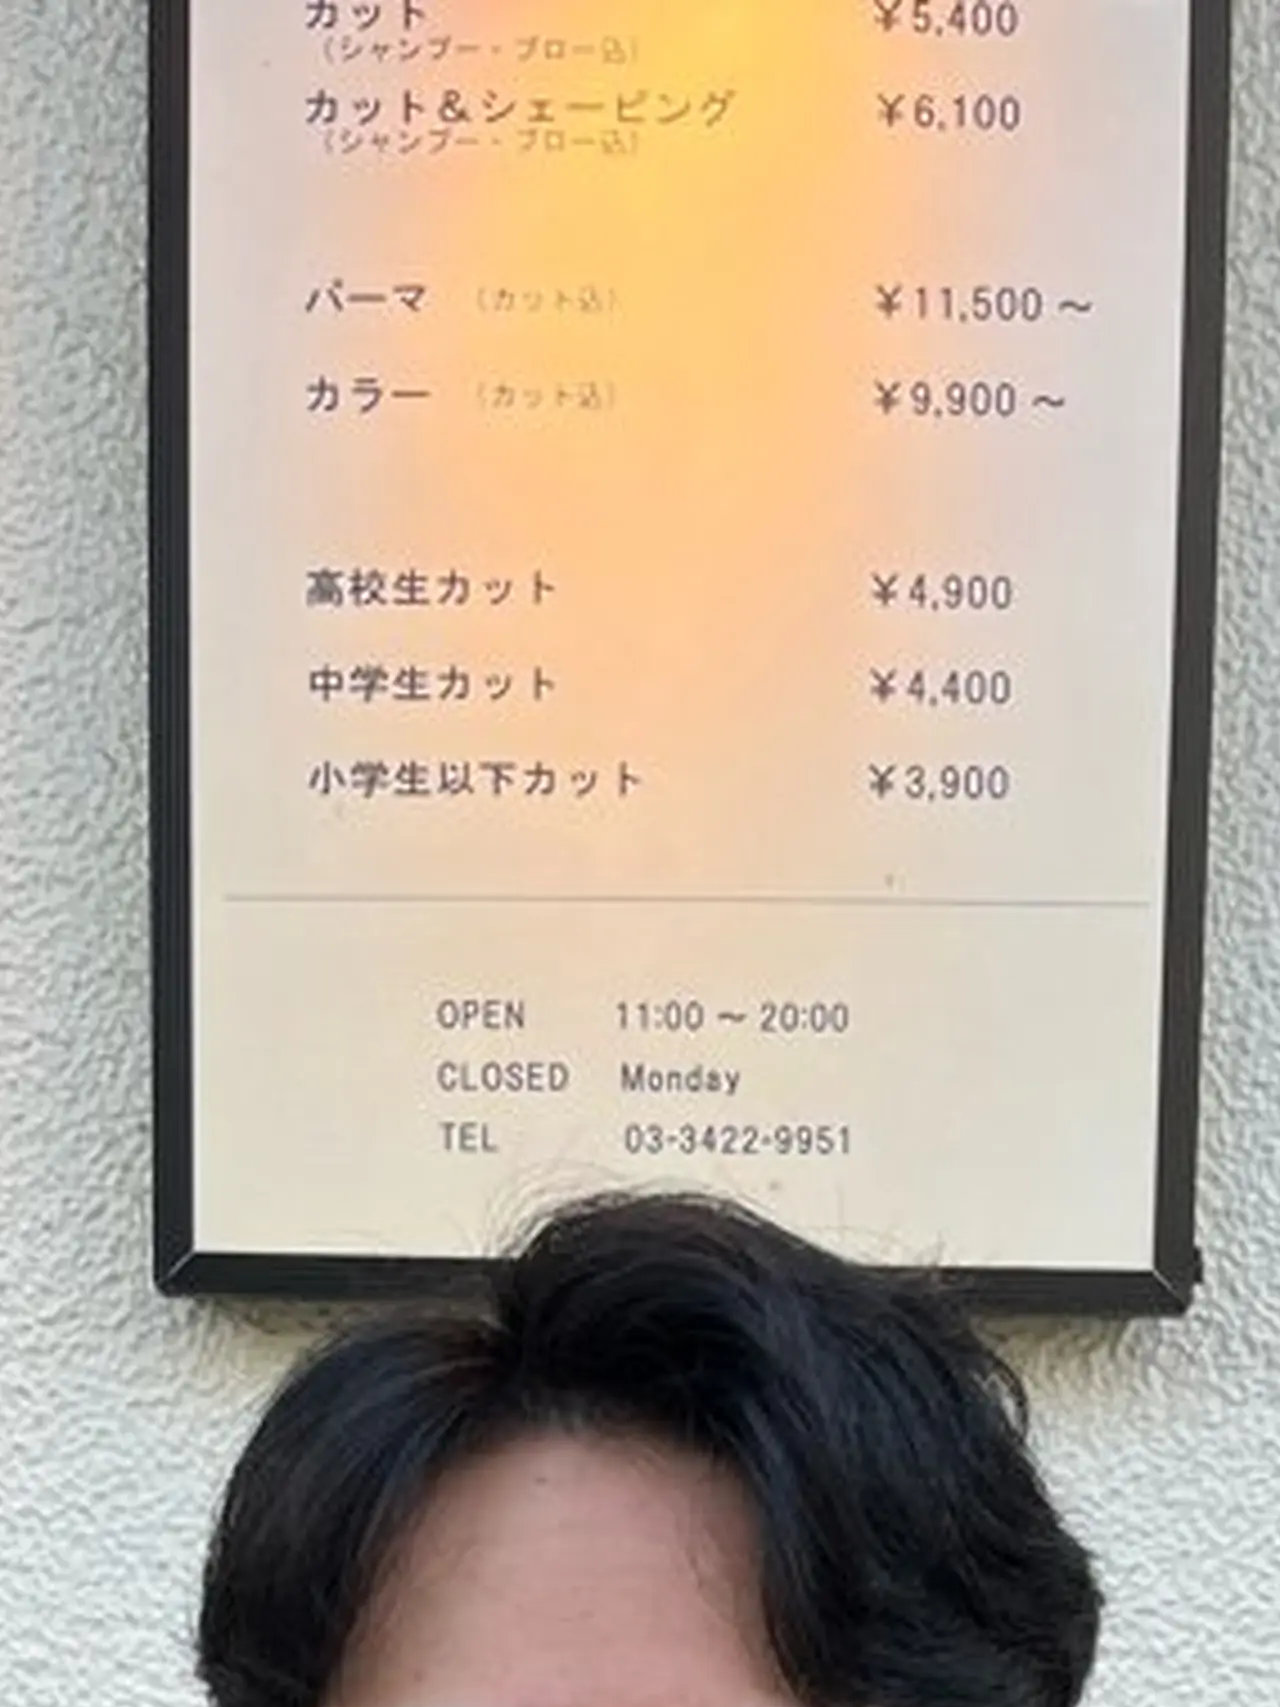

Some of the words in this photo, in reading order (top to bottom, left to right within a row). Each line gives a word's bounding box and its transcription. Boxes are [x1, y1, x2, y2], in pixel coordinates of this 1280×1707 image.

[306, 0, 424, 31] カット
[305, 279, 425, 313] パーマ
[307, 376, 430, 414] カラー
[307, 568, 554, 607] 高校生カット
[309, 663, 553, 703] 中学生カット
[309, 760, 639, 799] 小学生以下カット
[436, 999, 524, 1032] OPEN
[617, 1000, 704, 1033] 11:00
[760, 1001, 849, 1033] 20:00
[437, 1059, 569, 1092] CLOSED
[621, 1062, 740, 1096] Monday
[440, 1121, 498, 1153] TEL
[625, 1123, 849, 1155] 03-3422-9951
